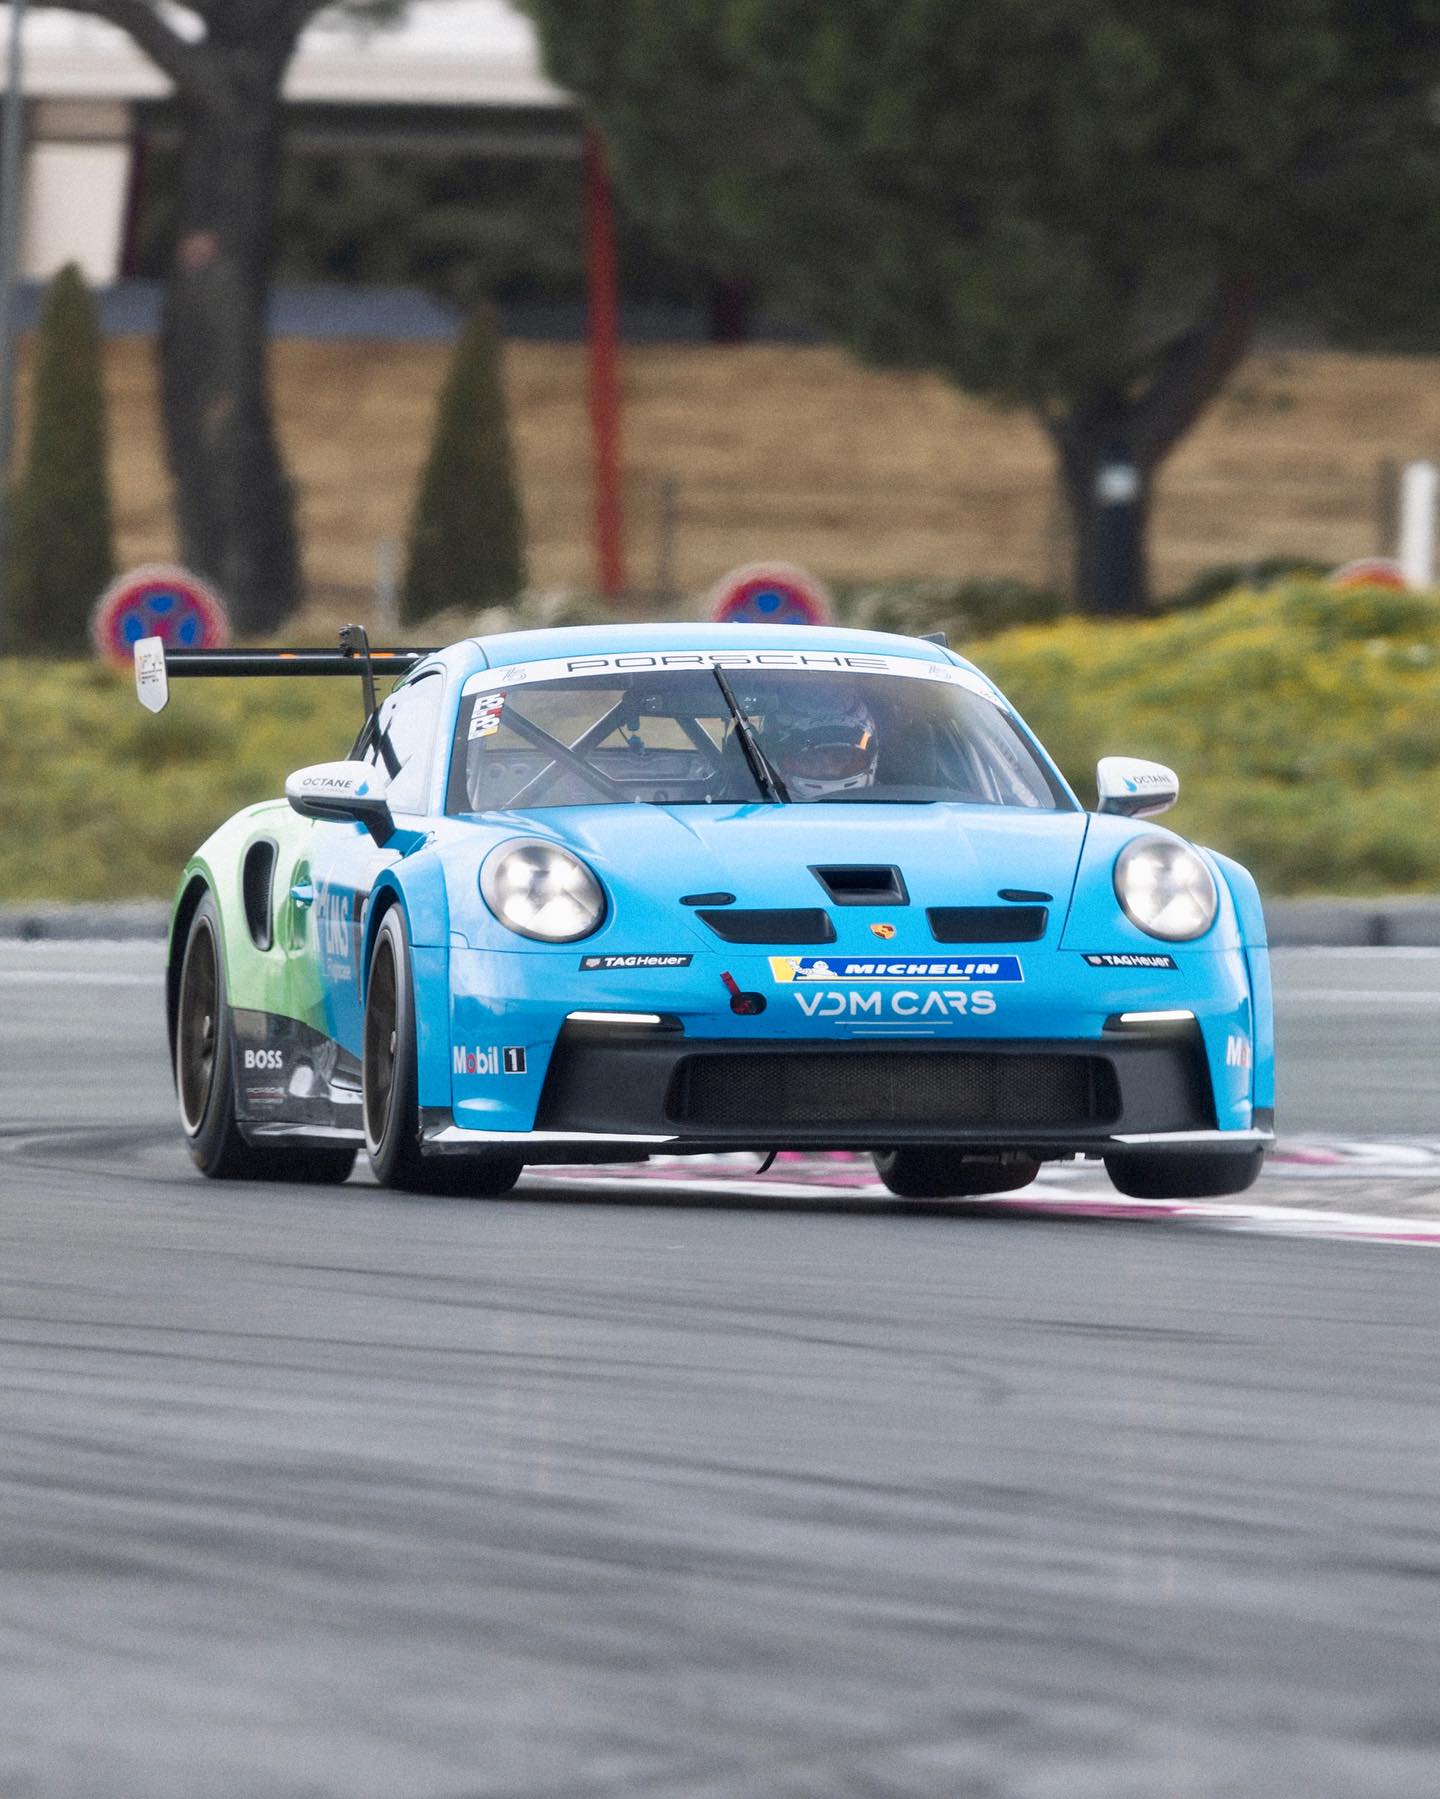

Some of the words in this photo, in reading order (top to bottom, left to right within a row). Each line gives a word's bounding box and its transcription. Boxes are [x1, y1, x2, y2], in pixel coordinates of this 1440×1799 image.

[567, 655, 889, 672] PORSCHE
[302, 778, 353, 789] OCTANE
[845, 963, 999, 975] MICHELIN
[793, 991, 881, 1016] VDM
[891, 990, 997, 1016] CARS
[245, 1049, 283, 1069] BOSS
[453, 1046, 499, 1074] Mobil
